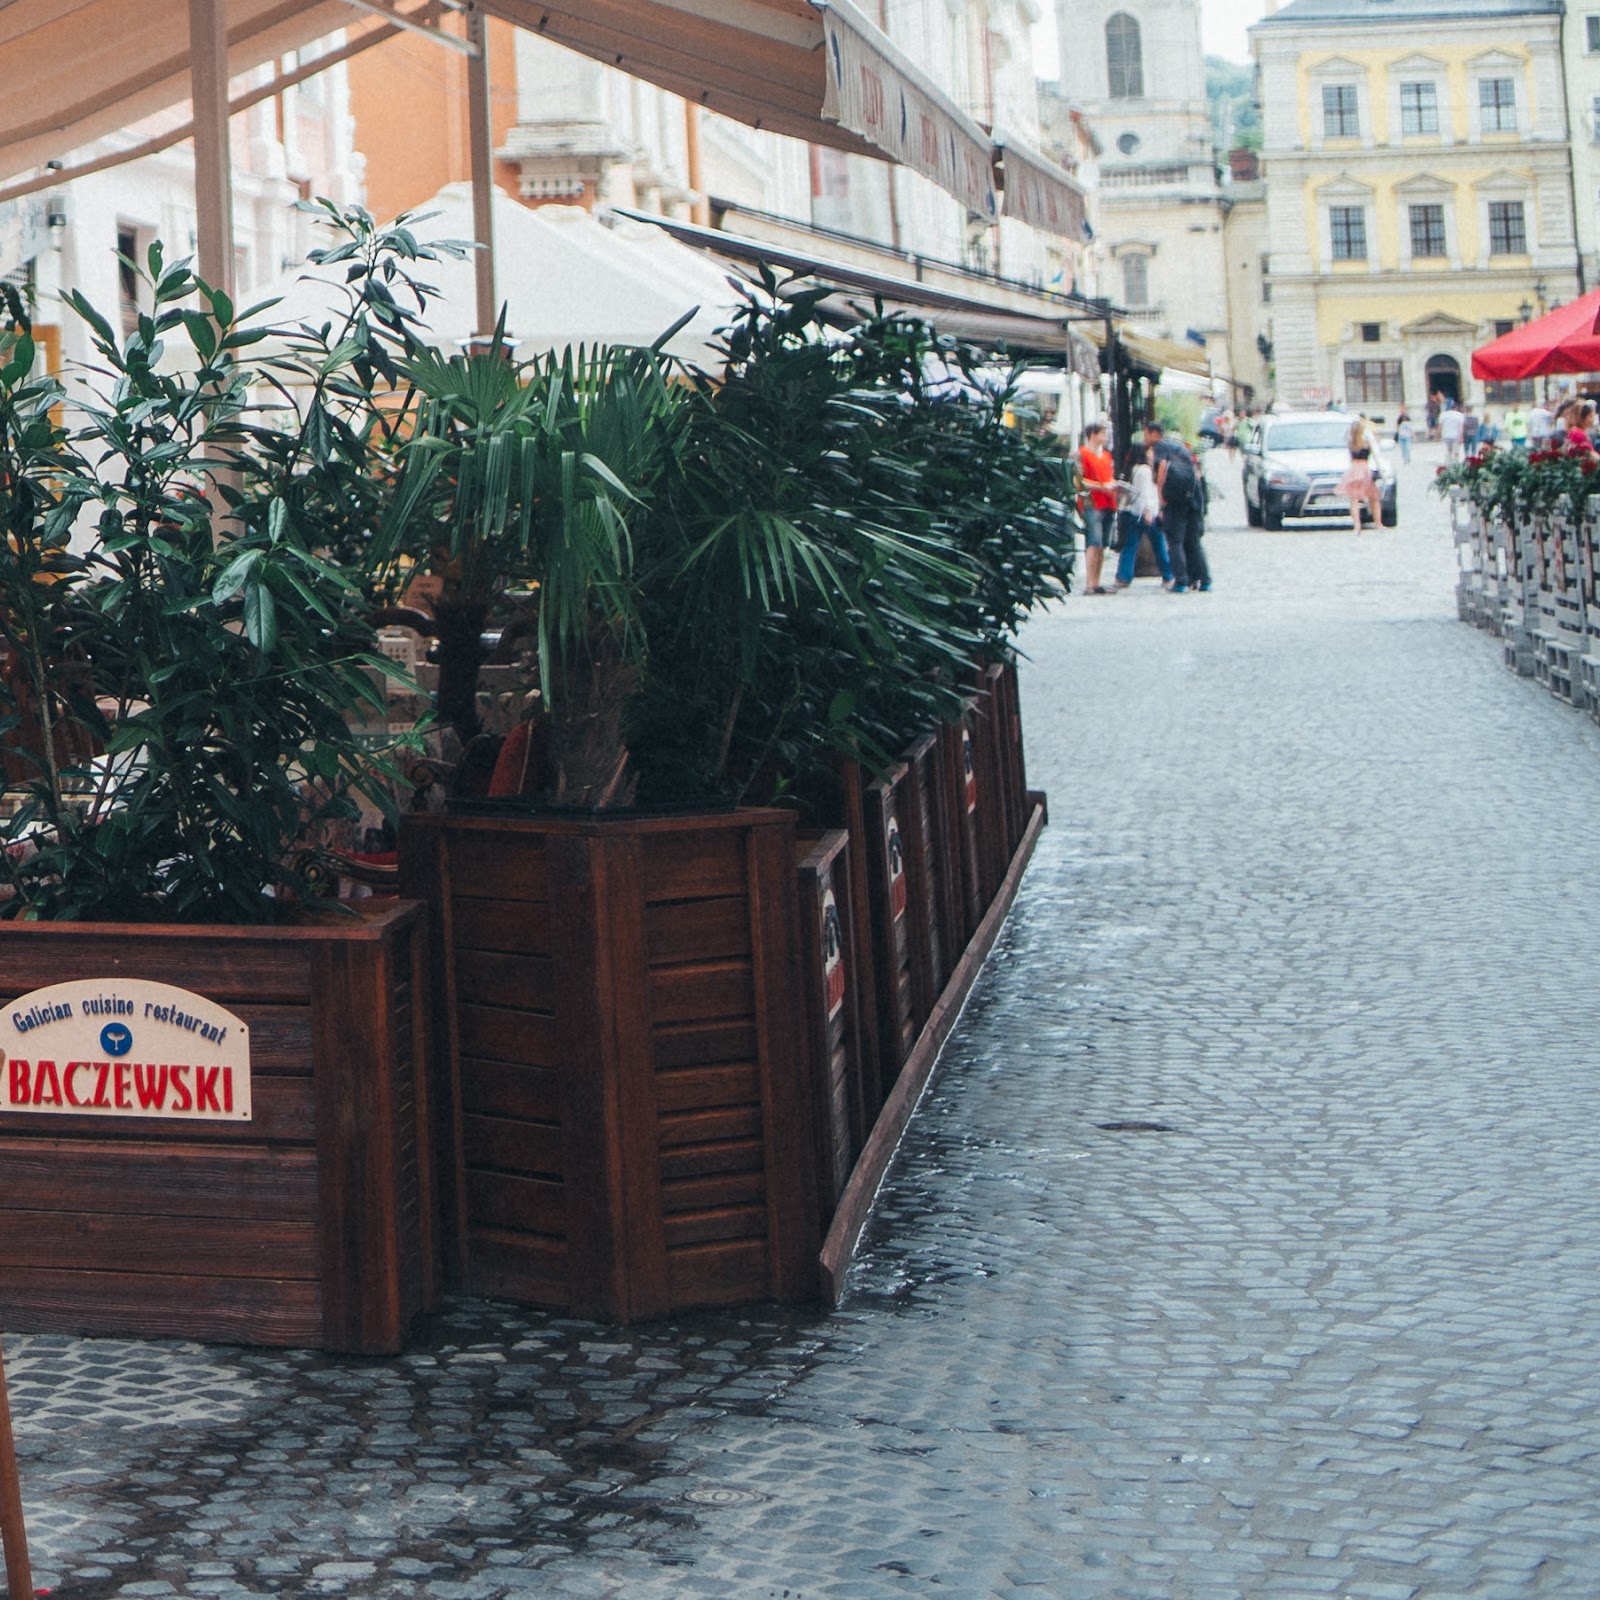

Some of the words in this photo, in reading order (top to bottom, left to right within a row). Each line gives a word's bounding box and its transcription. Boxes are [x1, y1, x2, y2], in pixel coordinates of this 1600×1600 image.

[13, 1001, 73, 1033] Galician
[82, 994, 134, 1015] cuisine
[144, 1003, 227, 1045] restaurant
[9, 1059, 233, 1112] BACZEWSKI
